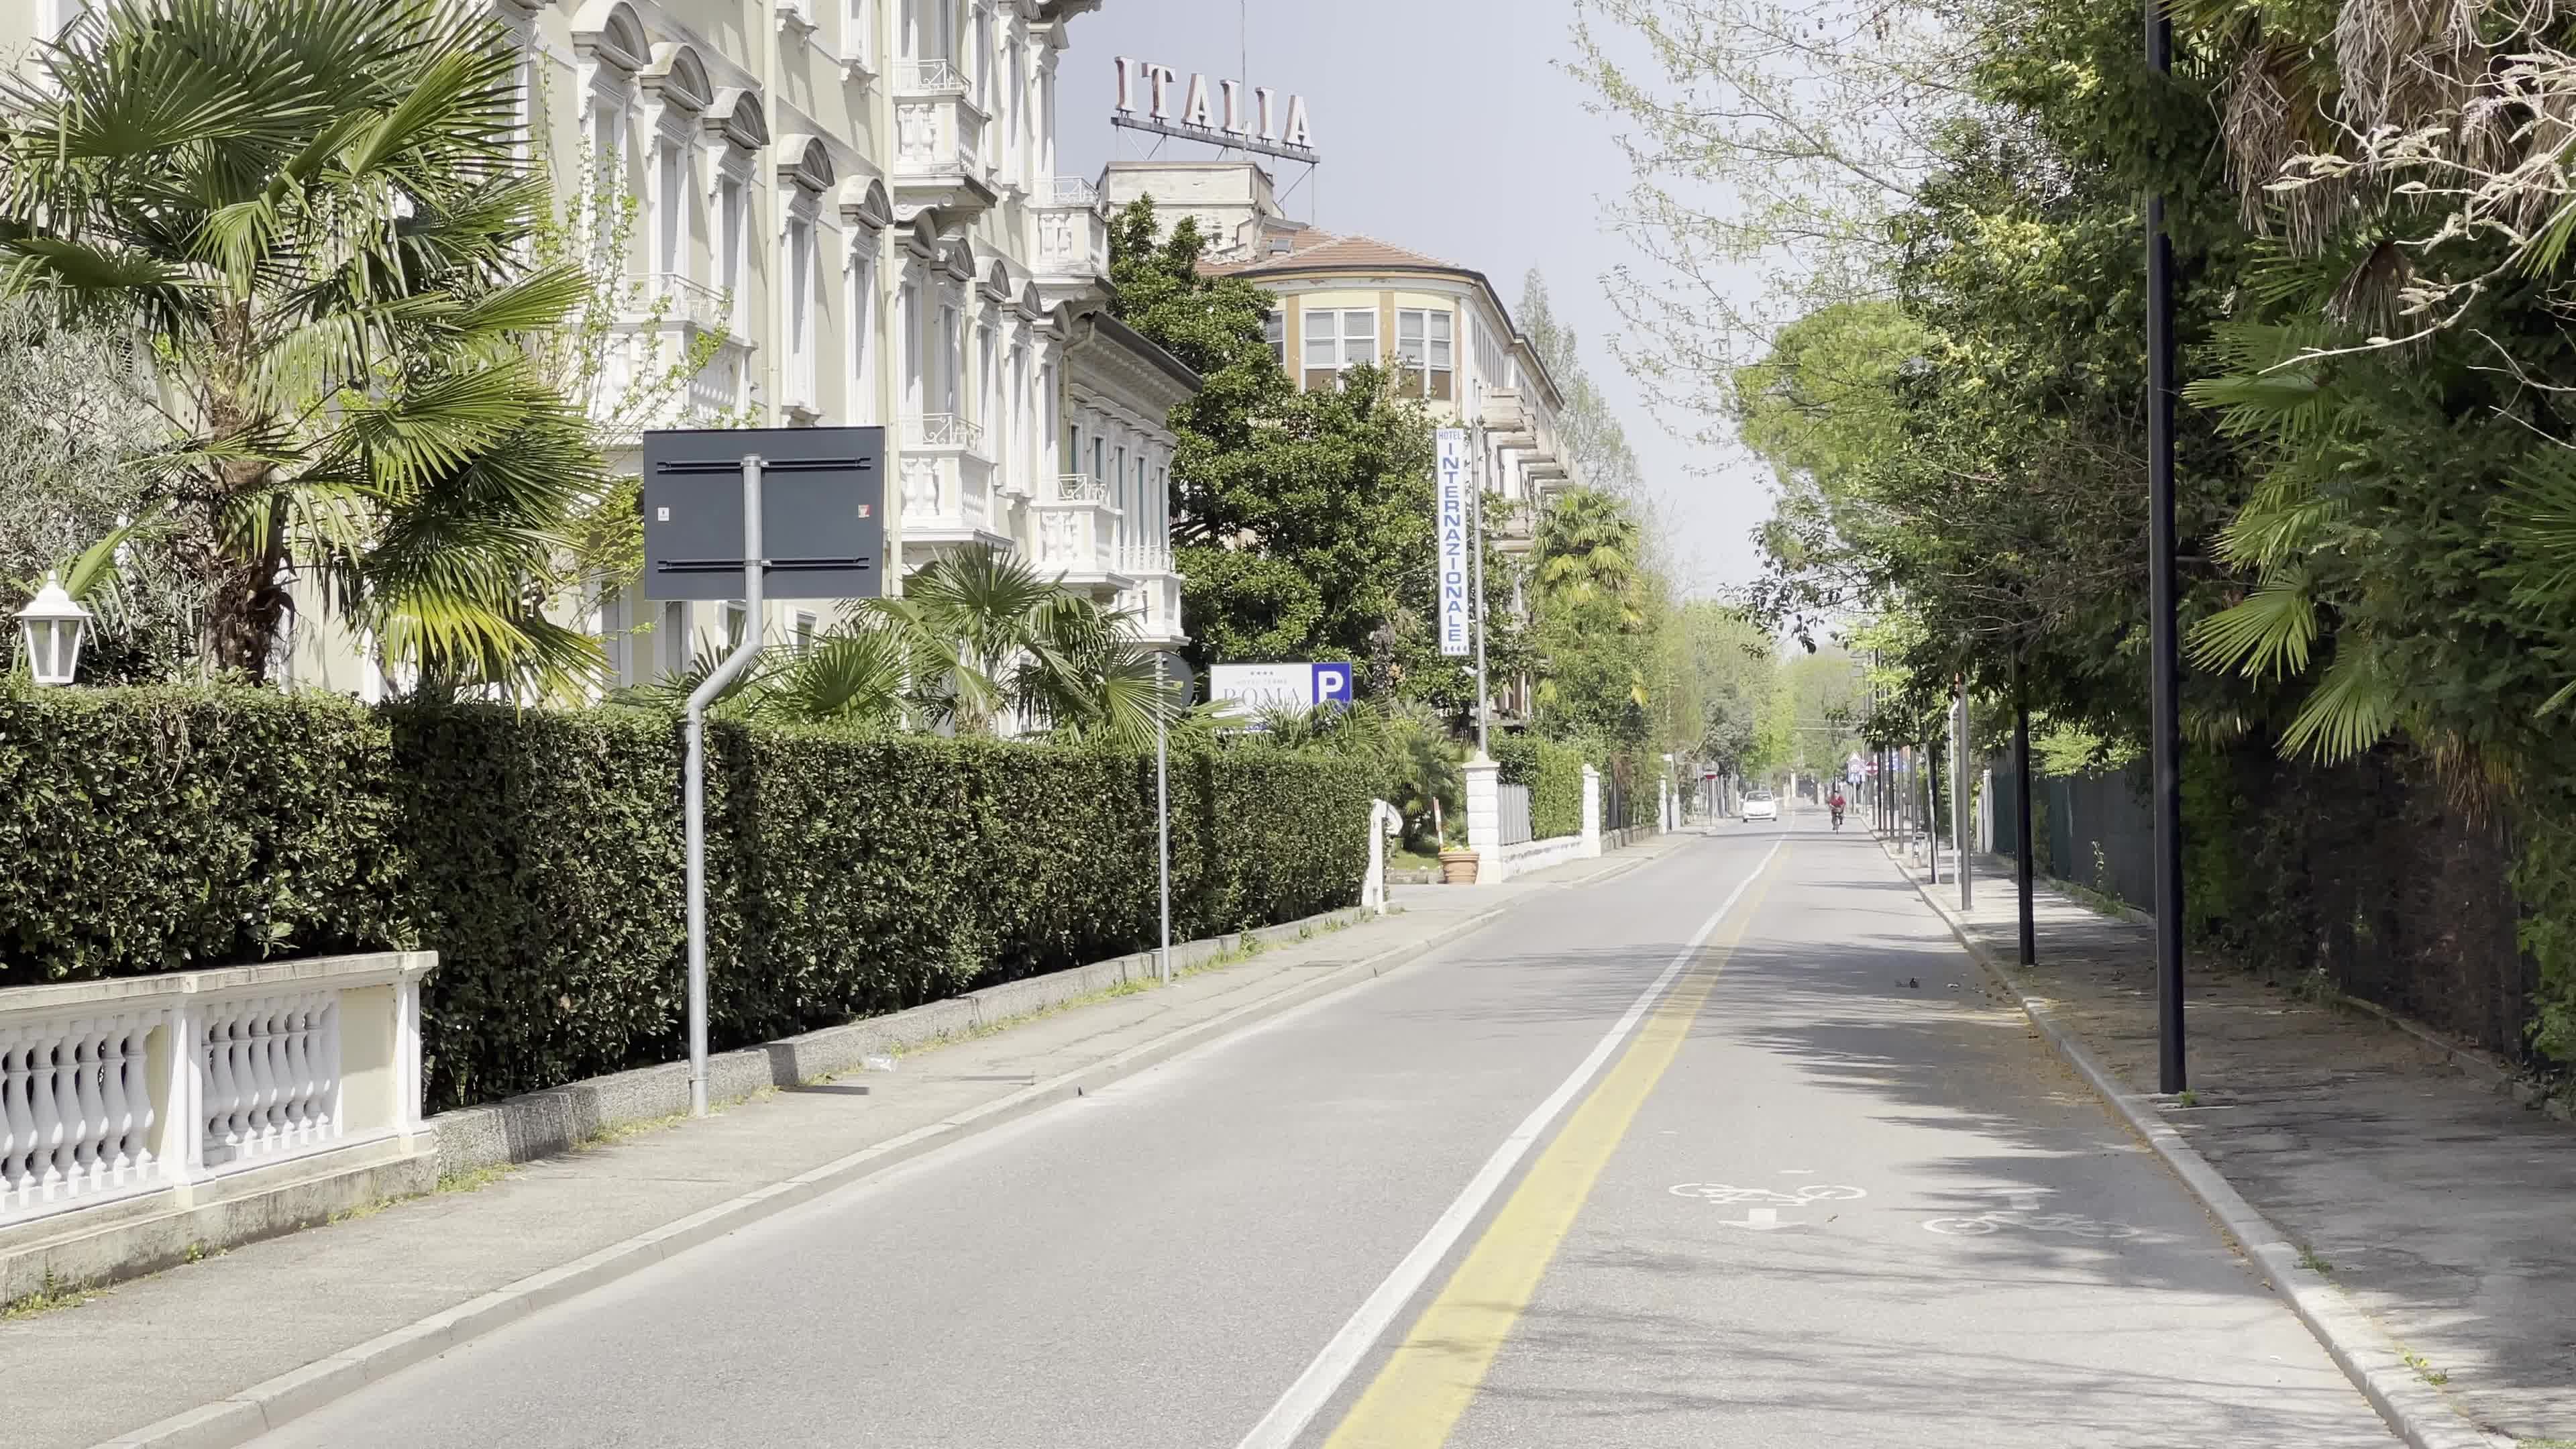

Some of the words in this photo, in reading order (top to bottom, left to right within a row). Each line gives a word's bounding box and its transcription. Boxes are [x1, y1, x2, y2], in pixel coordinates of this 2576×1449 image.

[1114, 56, 1315, 148] ITALIA
[1438, 431, 1462, 440] HOTEL
[1442, 443, 1462, 642] INTERNAZIONALE
[1318, 671, 1344, 703] P
